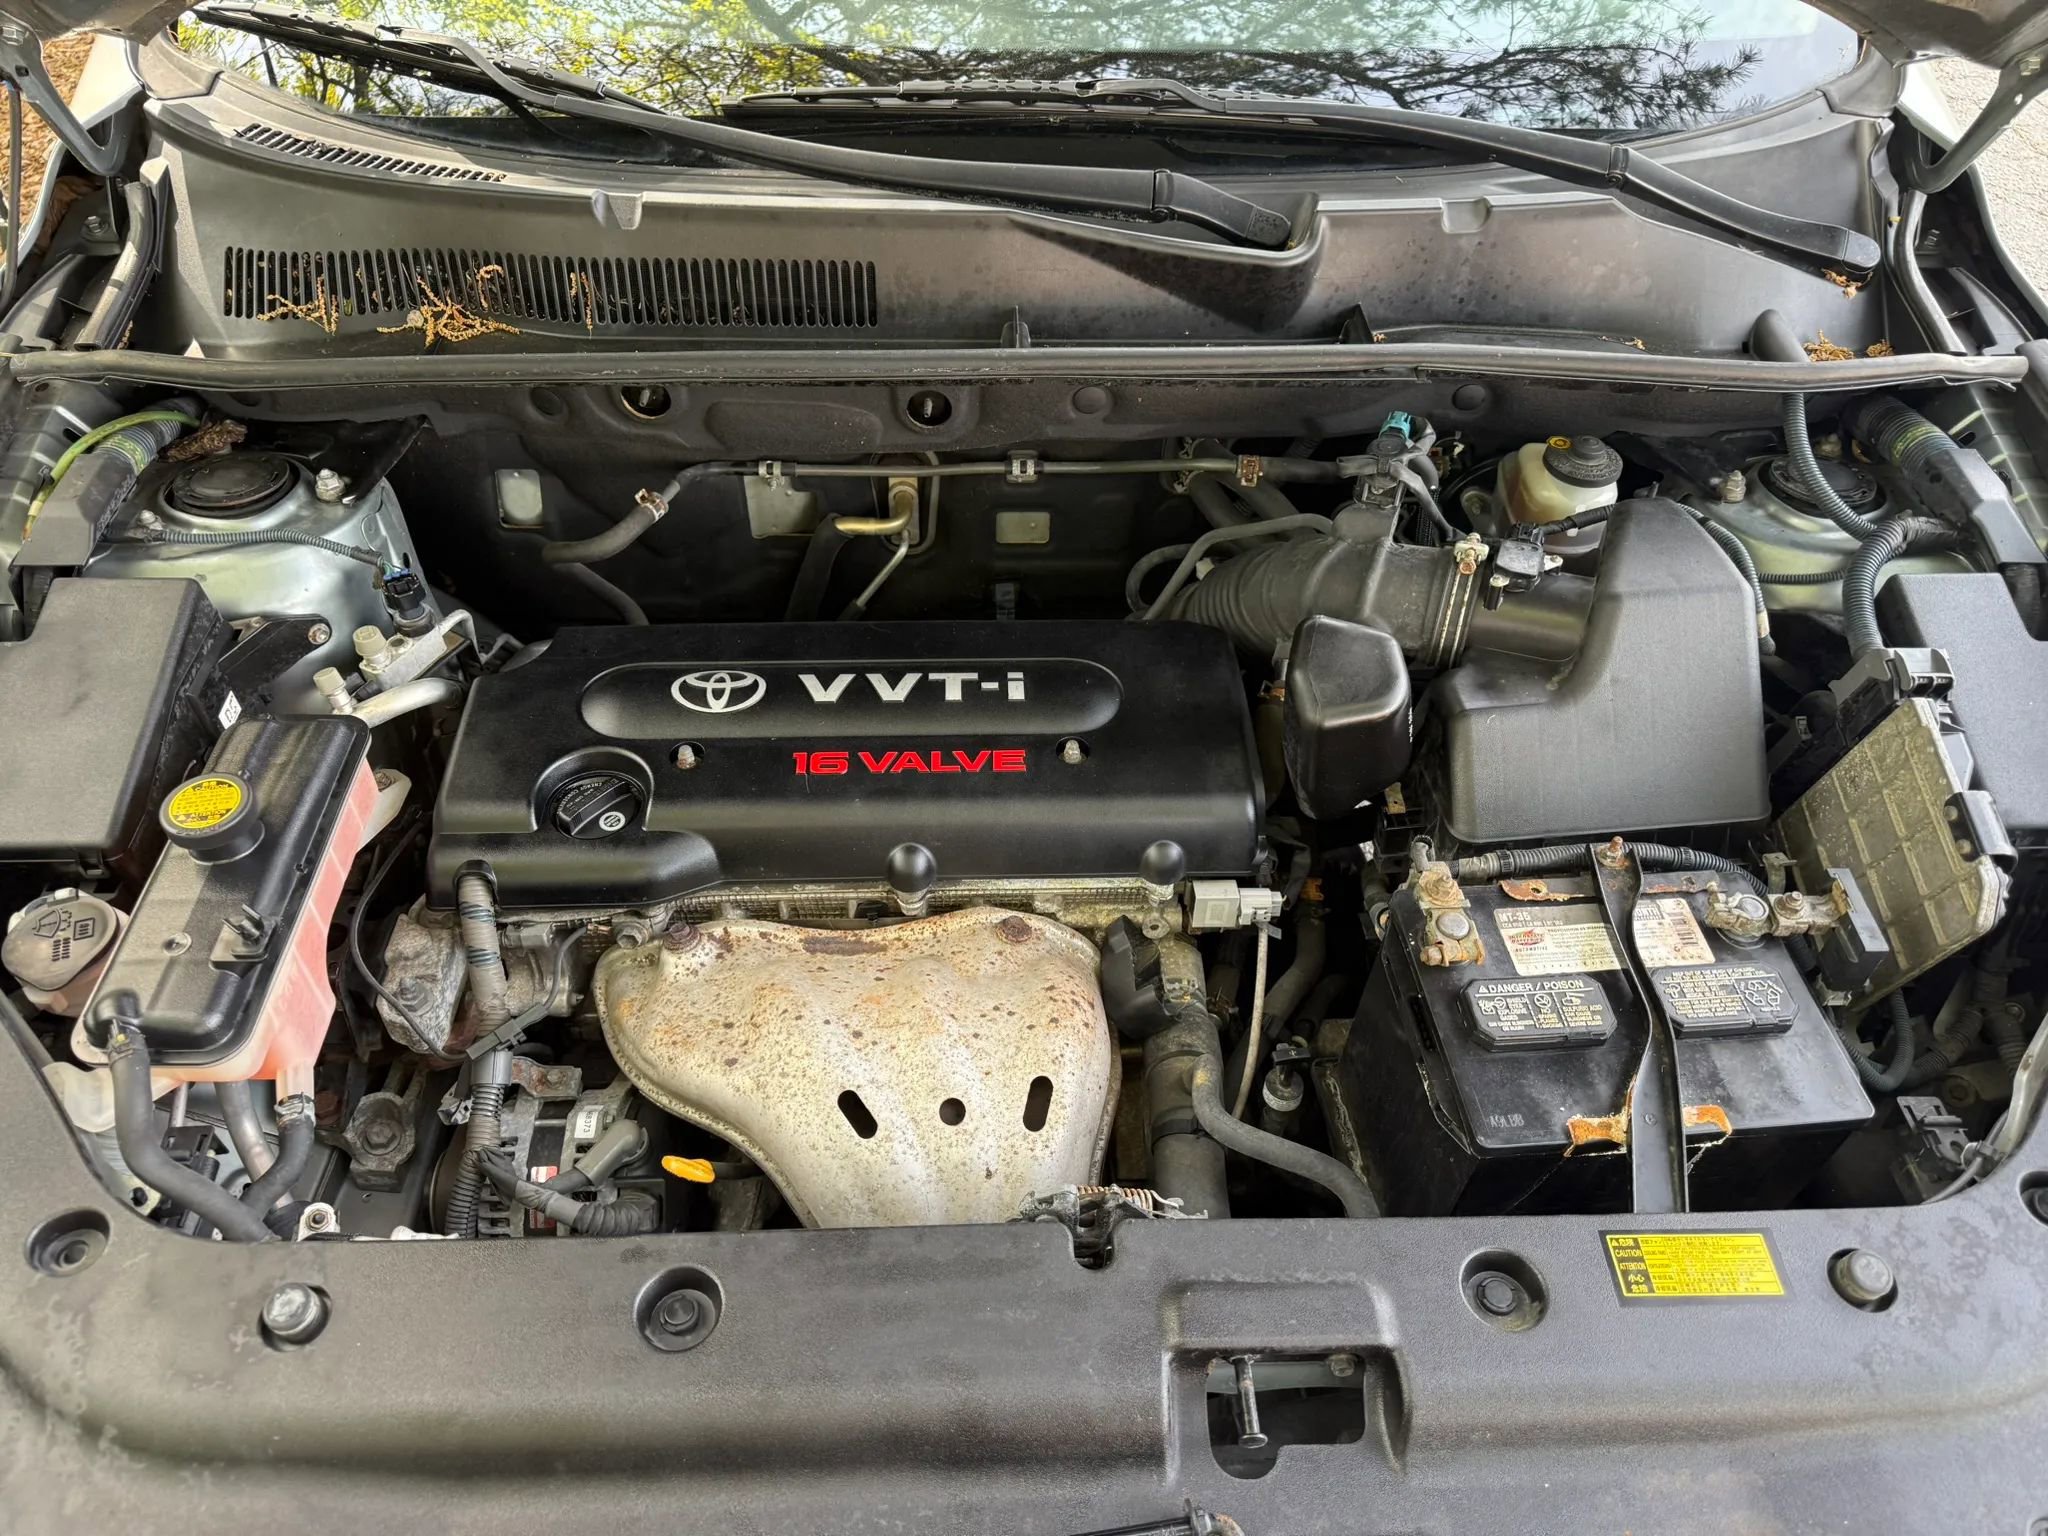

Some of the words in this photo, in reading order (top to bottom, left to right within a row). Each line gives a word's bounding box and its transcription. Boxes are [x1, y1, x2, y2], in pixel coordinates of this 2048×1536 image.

[798, 671, 1025, 702] VVT-i
[793, 751, 849, 775] 16
[857, 750, 1027, 773] VALVE
[1515, 945, 1548, 953] AUTOMOTIVE
[1488, 983, 1533, 993] DANGER
[1543, 979, 1585, 990] POISON
[1615, 1249, 1642, 1257] CAUTION
[1620, 1262, 1647, 1270] ATTENTION
